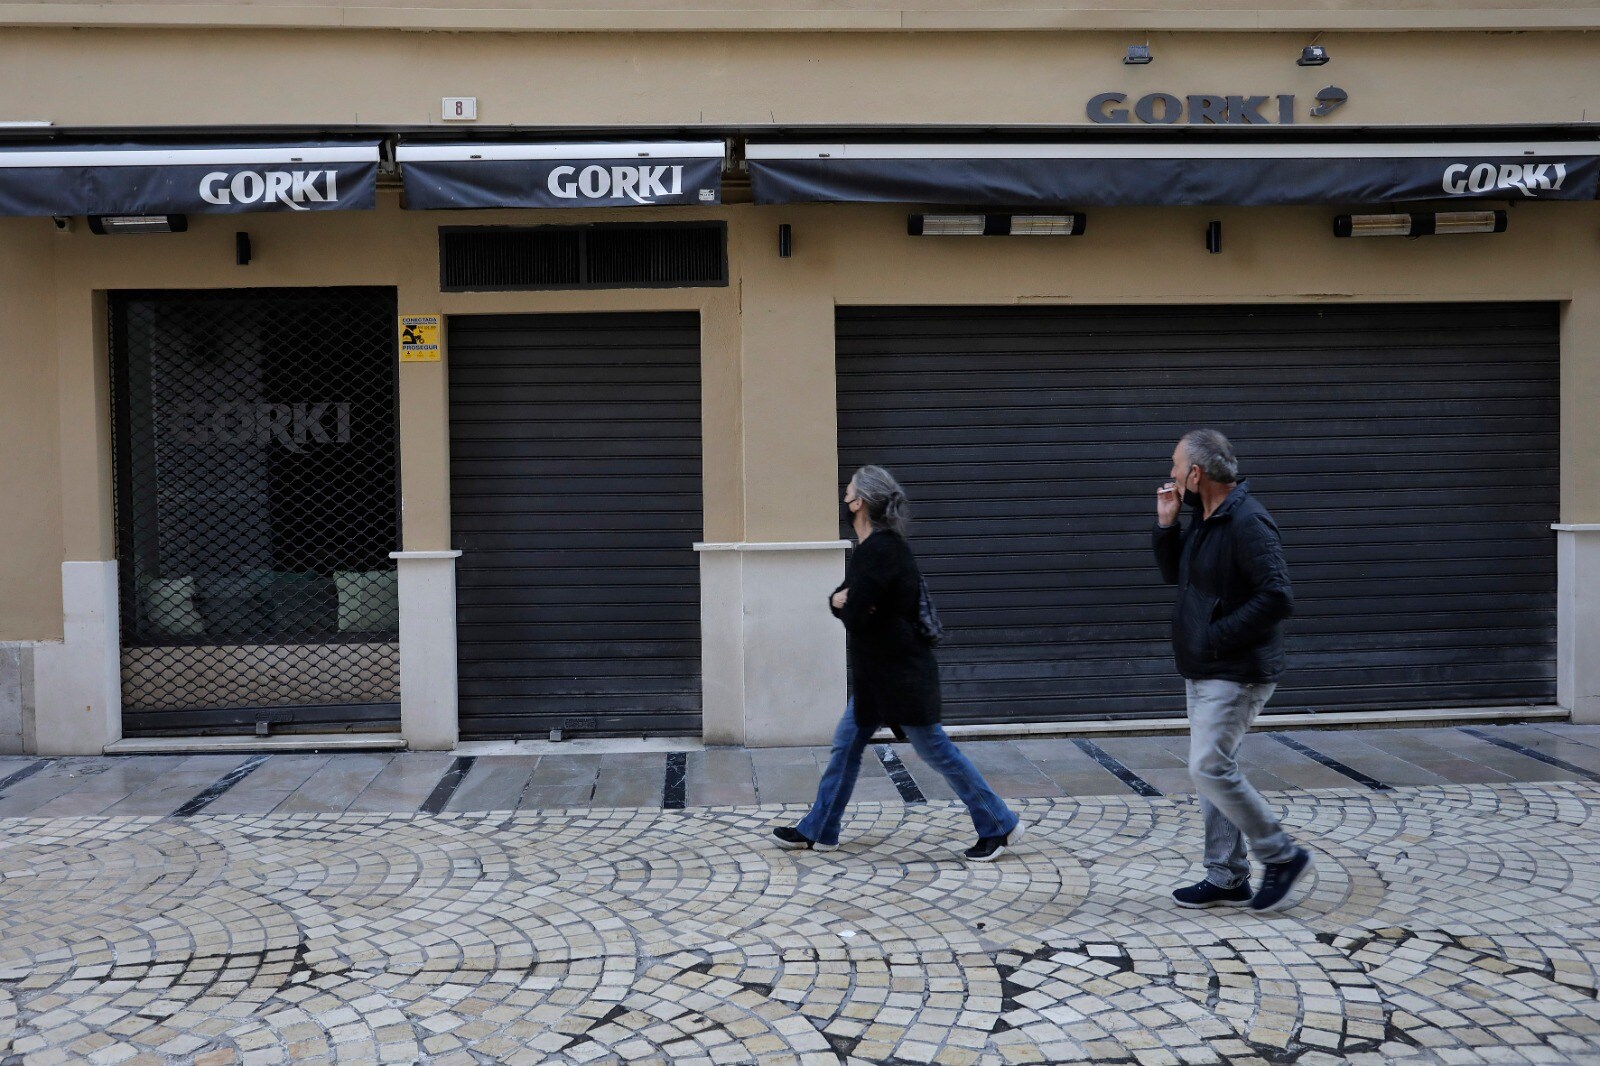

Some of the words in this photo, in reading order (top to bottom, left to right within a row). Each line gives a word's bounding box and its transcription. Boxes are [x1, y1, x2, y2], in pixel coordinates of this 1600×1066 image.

[455, 100, 463, 116] 8
[1086, 92, 1295, 124] GORKI
[199, 170, 339, 211] GORKI
[547, 165, 684, 204] GORKI
[1442, 163, 1567, 197] GORKI
